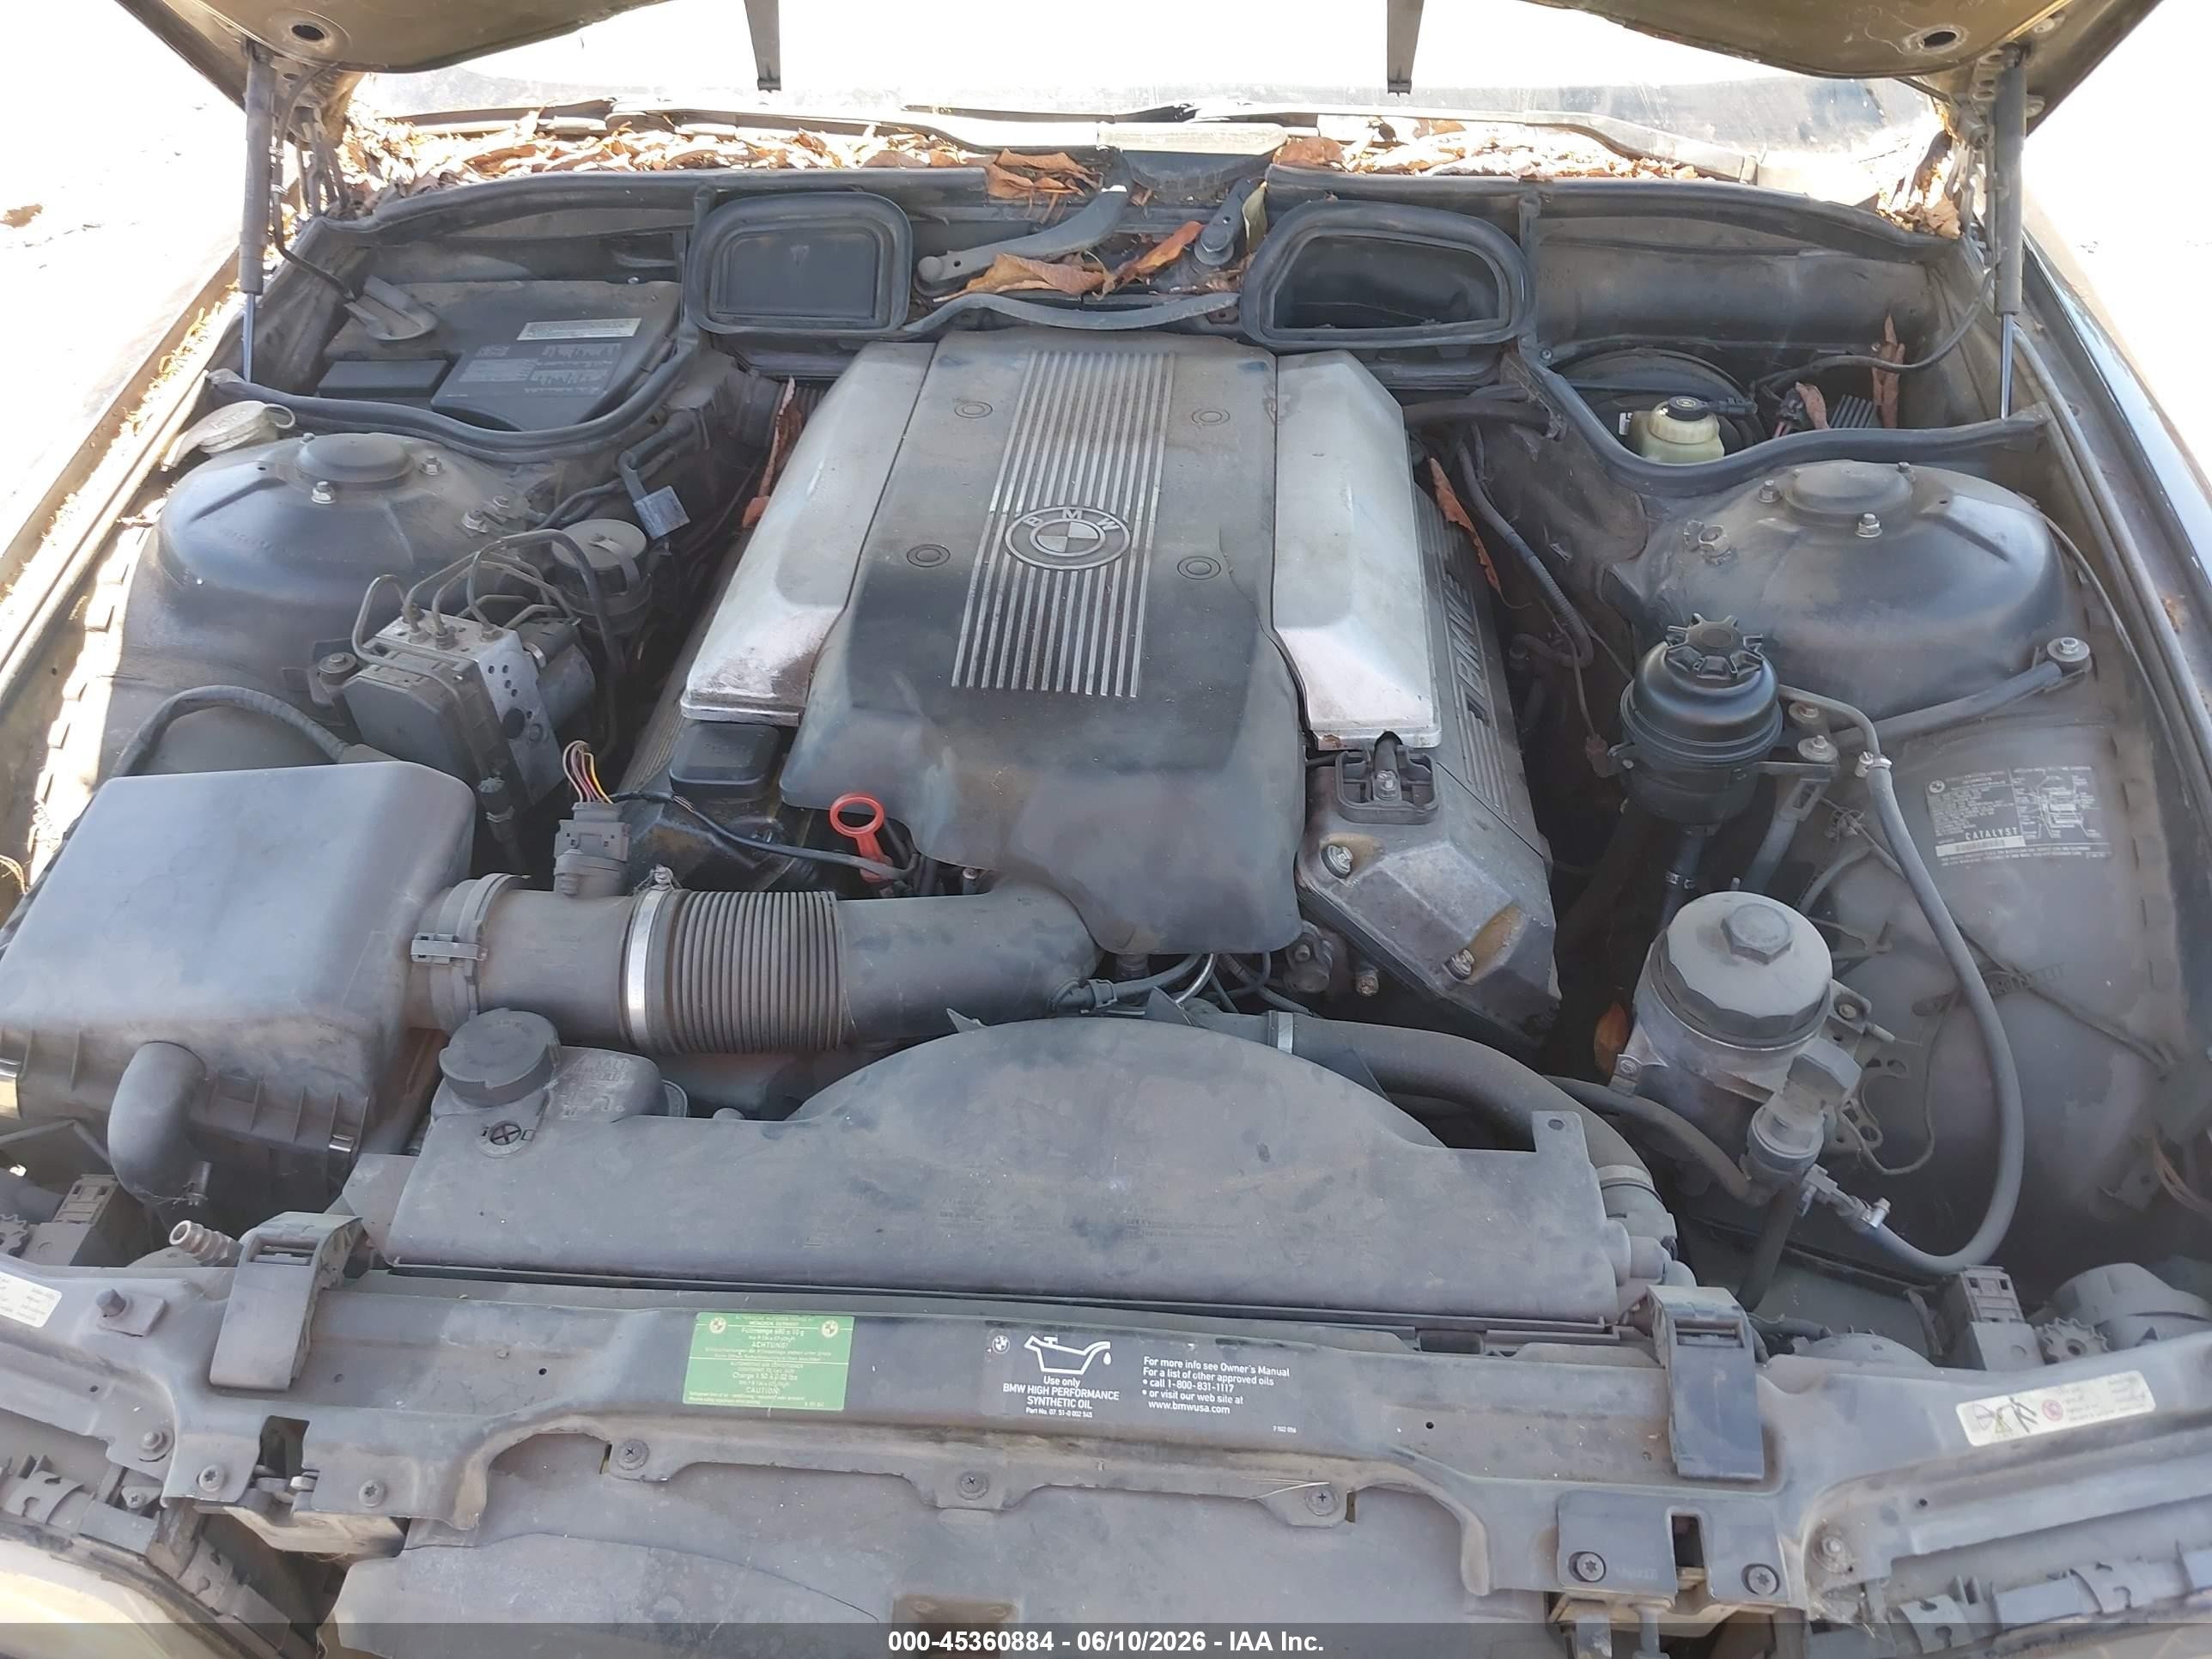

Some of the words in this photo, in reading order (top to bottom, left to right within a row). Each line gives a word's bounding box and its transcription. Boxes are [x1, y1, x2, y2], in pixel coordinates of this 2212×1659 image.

[1023, 508, 1120, 531] BMW
[1965, 826, 2018, 841] CATALYST
[1143, 1356, 1159, 1366] For
[1160, 1358, 1183, 1369] more
[1185, 1359, 1201, 1370] info
[1203, 1363, 1218, 1371] see
[1220, 1362, 1256, 1374] Owner's
[1258, 1365, 1290, 1376] Manual
[1044, 1376, 1060, 1385] Use
[1061, 1377, 1080, 1389] only
[1143, 1367, 1158, 1376] For
[1167, 1369, 1181, 1378] list
[1182, 1370, 1192, 1379] of
[1192, 1372, 1216, 1382] other
[1217, 1374, 1257, 1385] approved
[1258, 1376, 1274, 1386] oils
[1003, 1382, 1026, 1394] BMW
[1027, 1386, 1049, 1395] HIGH
[1051, 1387, 1120, 1401] PERFORMANCE
[1149, 1378, 1165, 1388] call
[1168, 1379, 1234, 1393] 1-800-831-1117
[1027, 1396, 1076, 1408] SYNTHETIC
[1078, 1400, 1092, 1409] OIL
[1149, 1389, 1159, 1398] or
[1160, 1390, 1178, 1400] visit
[1197, 1393, 1215, 1402] web
[1217, 1395, 1233, 1404] site
[1234, 1396, 1244, 1405] at
[1148, 1401, 1231, 1414] www.bmwusa.com
